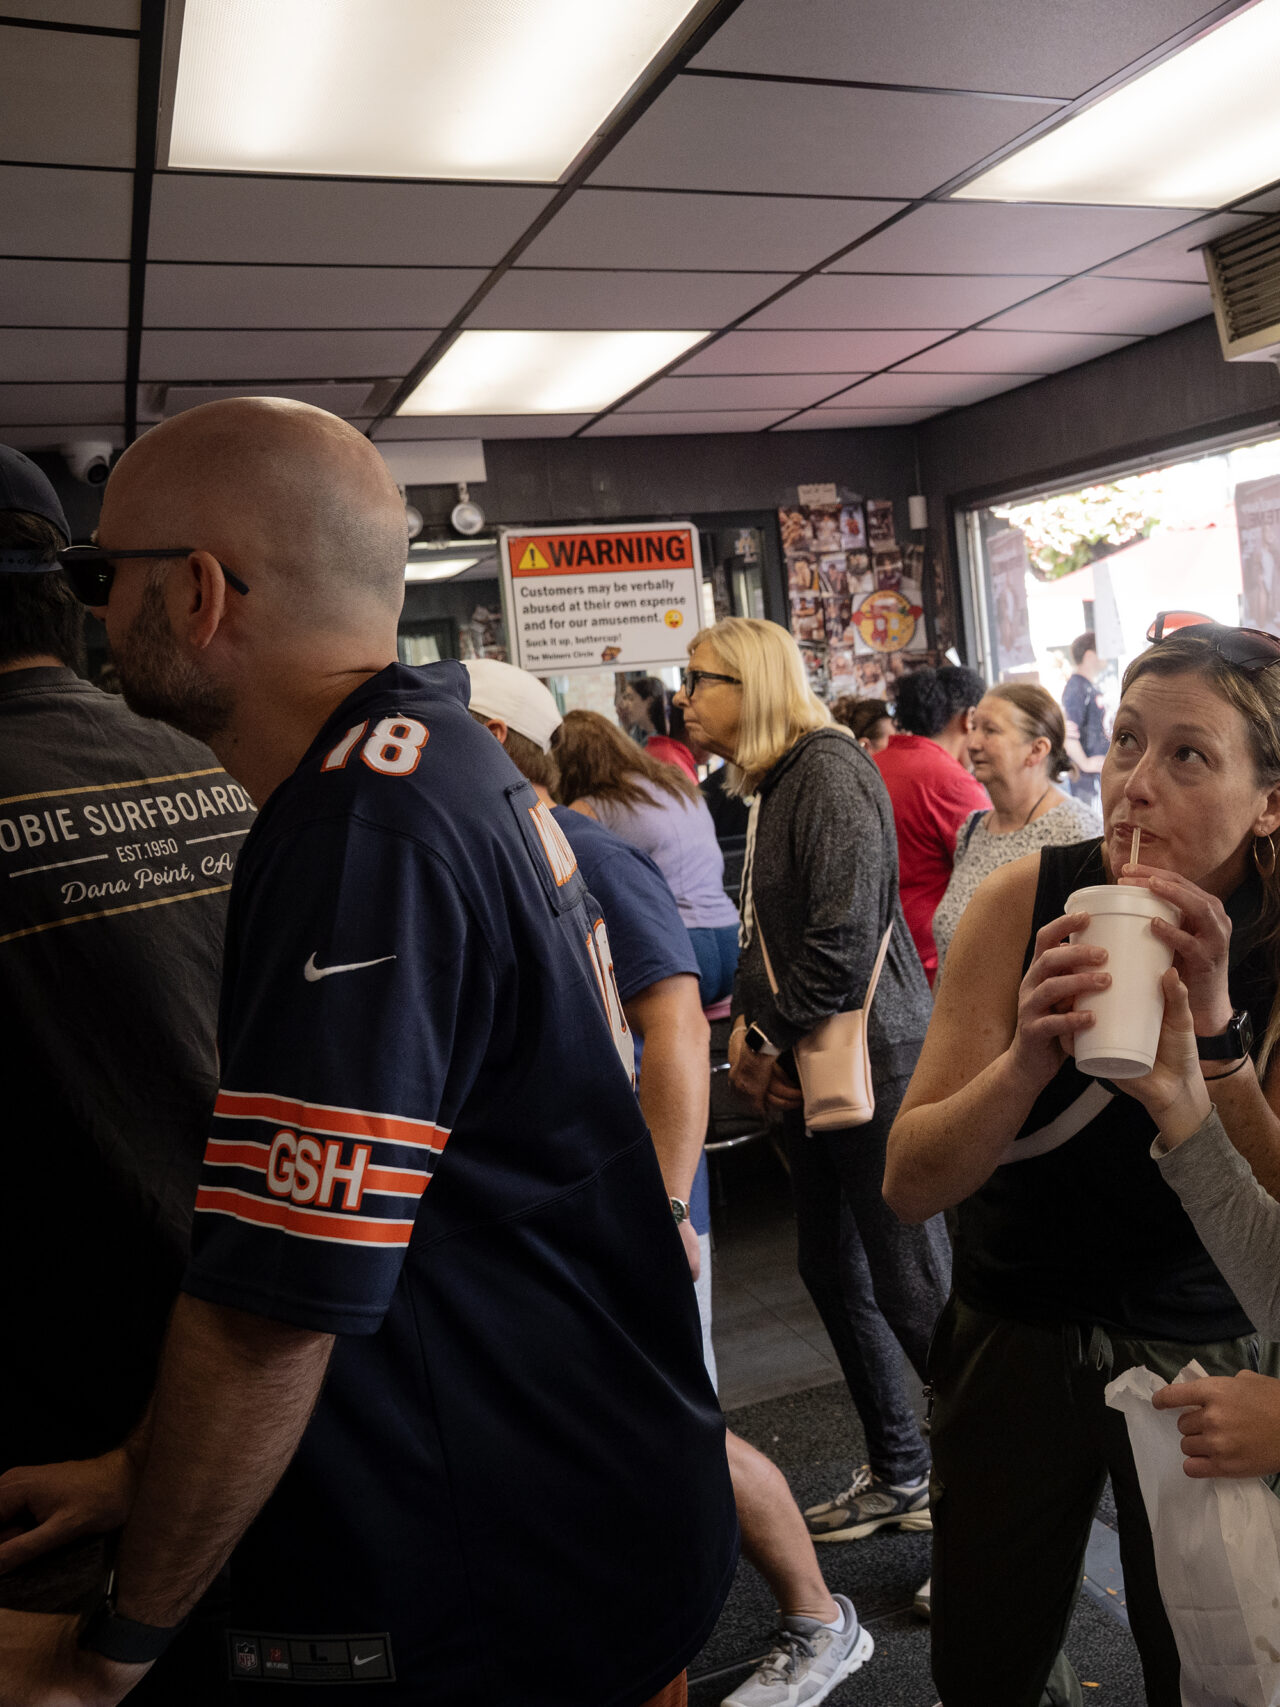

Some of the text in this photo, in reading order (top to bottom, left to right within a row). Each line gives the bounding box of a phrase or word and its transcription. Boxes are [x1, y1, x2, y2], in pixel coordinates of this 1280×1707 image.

[548, 535, 686, 568] WARNING
[520, 578, 675, 599] Customers may be verbally
[522, 595, 686, 615] abused at their own expense
[524, 612, 662, 632] and for our amusement.
[526, 633, 622, 648] Suck it up, buttercup!
[527, 654, 540, 662] The
[573, 651, 594, 659] Circle
[320, 716, 430, 776] 18
[115, 838, 179, 863] EST.1950
[61, 852, 234, 905] Dana Point, CA
[266, 1129, 372, 1211] GSH
